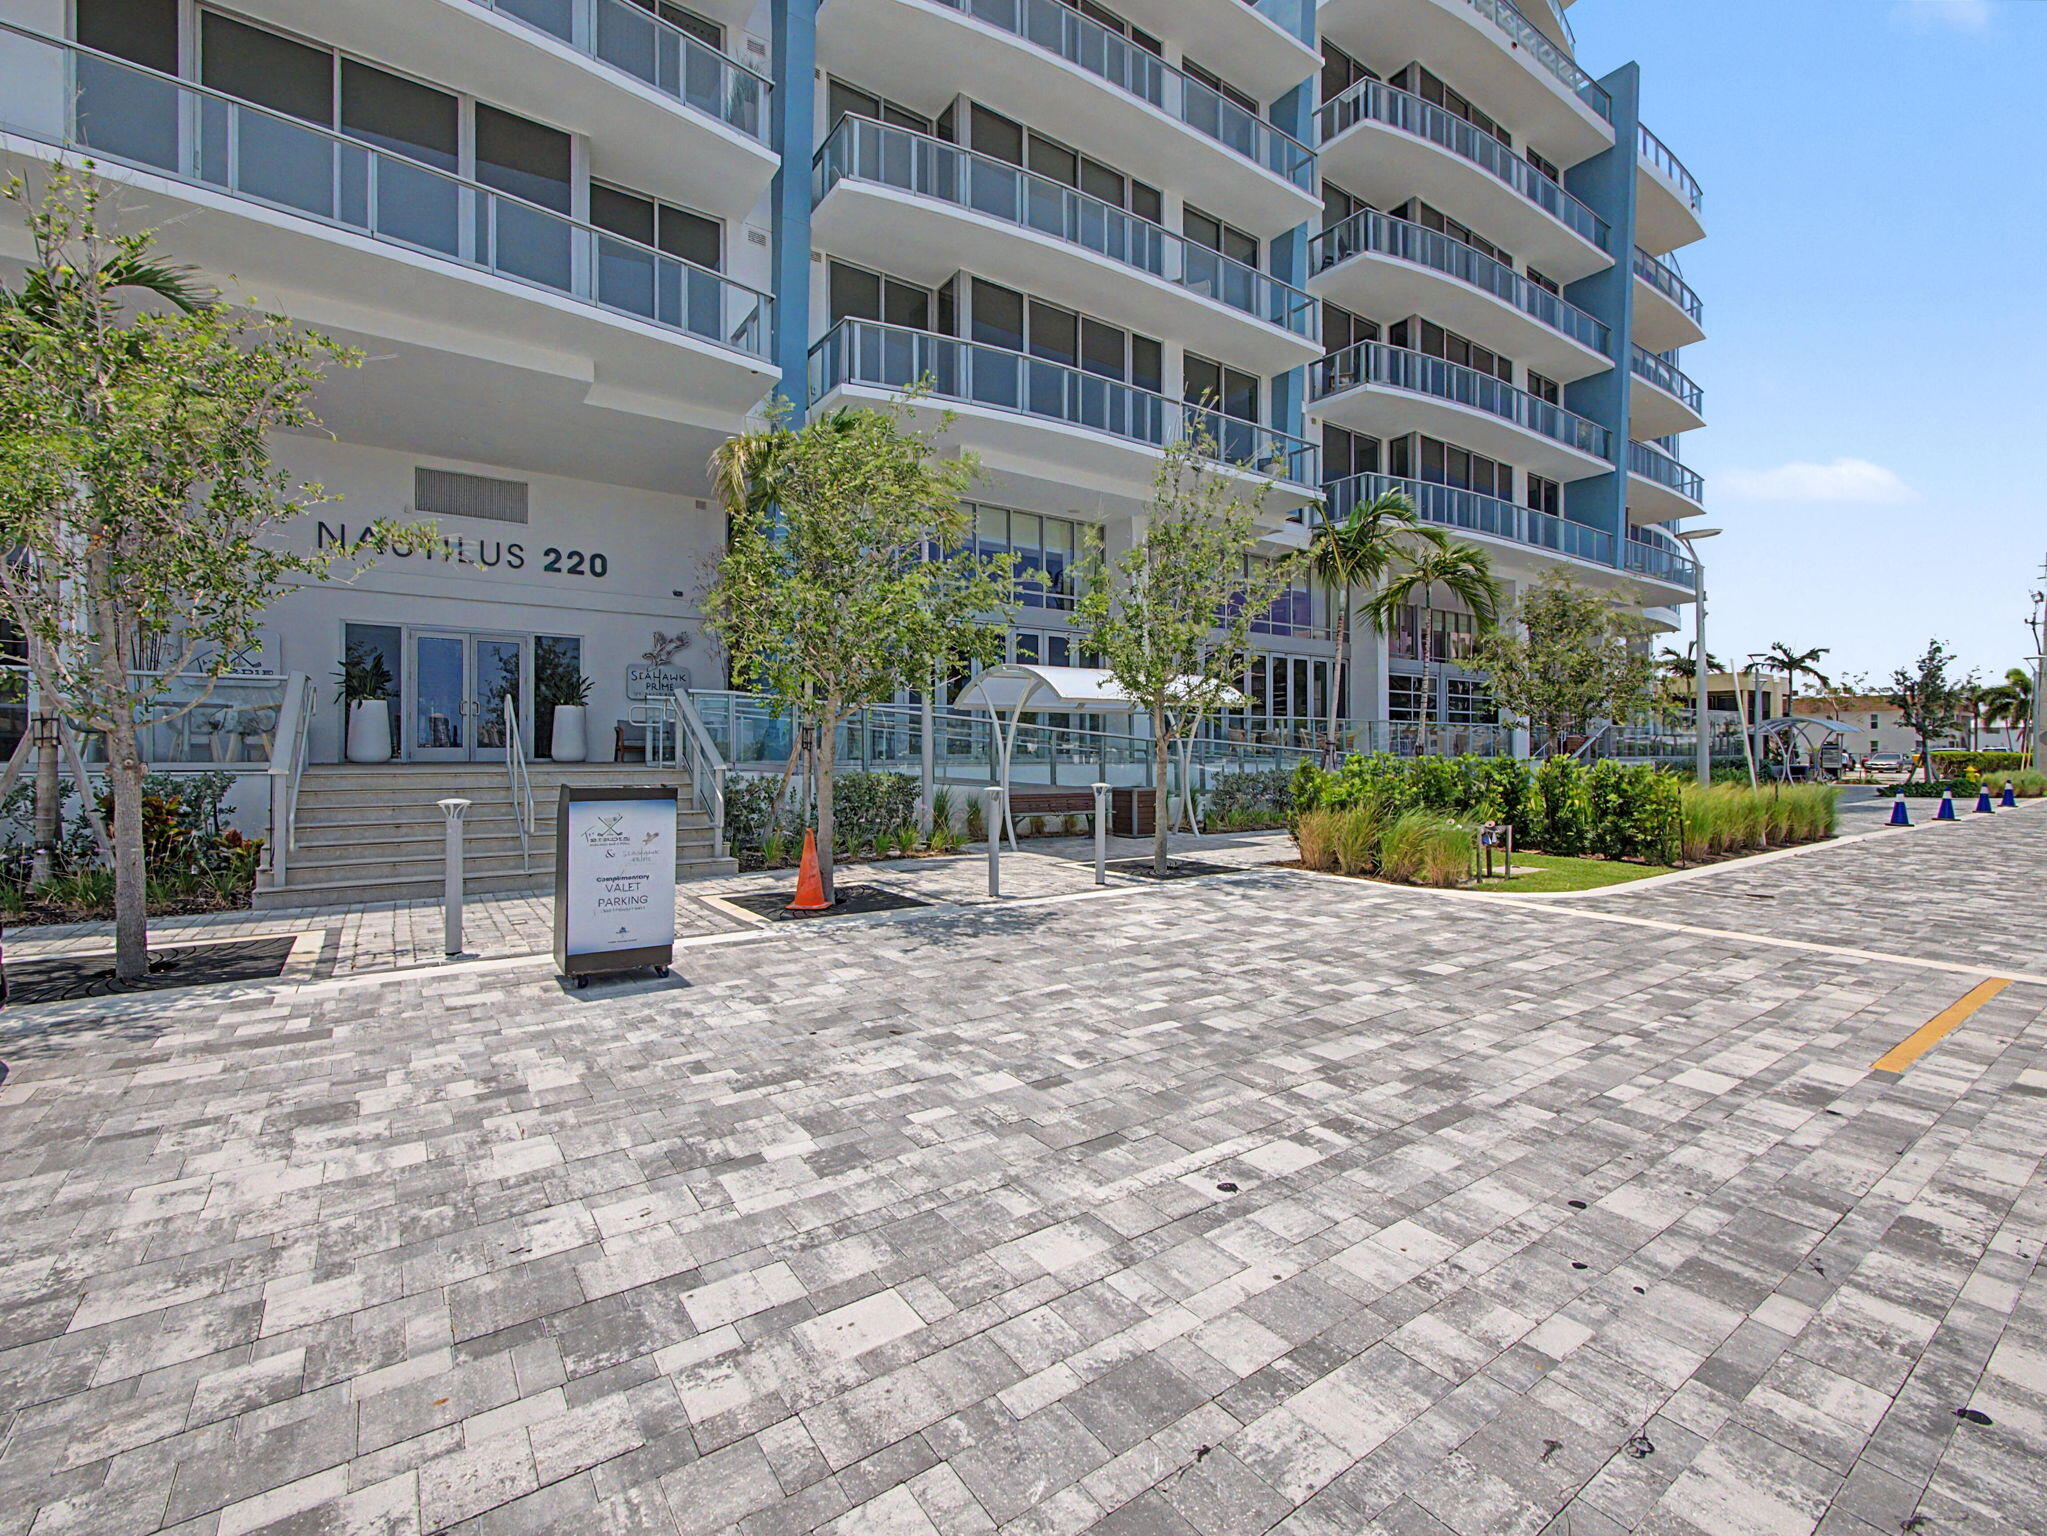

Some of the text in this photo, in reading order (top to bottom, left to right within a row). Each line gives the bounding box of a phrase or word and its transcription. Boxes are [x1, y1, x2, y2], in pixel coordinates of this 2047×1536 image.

[543, 547, 608, 578] 220
[631, 668, 687, 682] SEAHAWK
[645, 682, 675, 691] PRIME
[605, 849, 616, 858] &
[605, 882, 641, 893] VALET
[598, 895, 649, 907] PARKING
